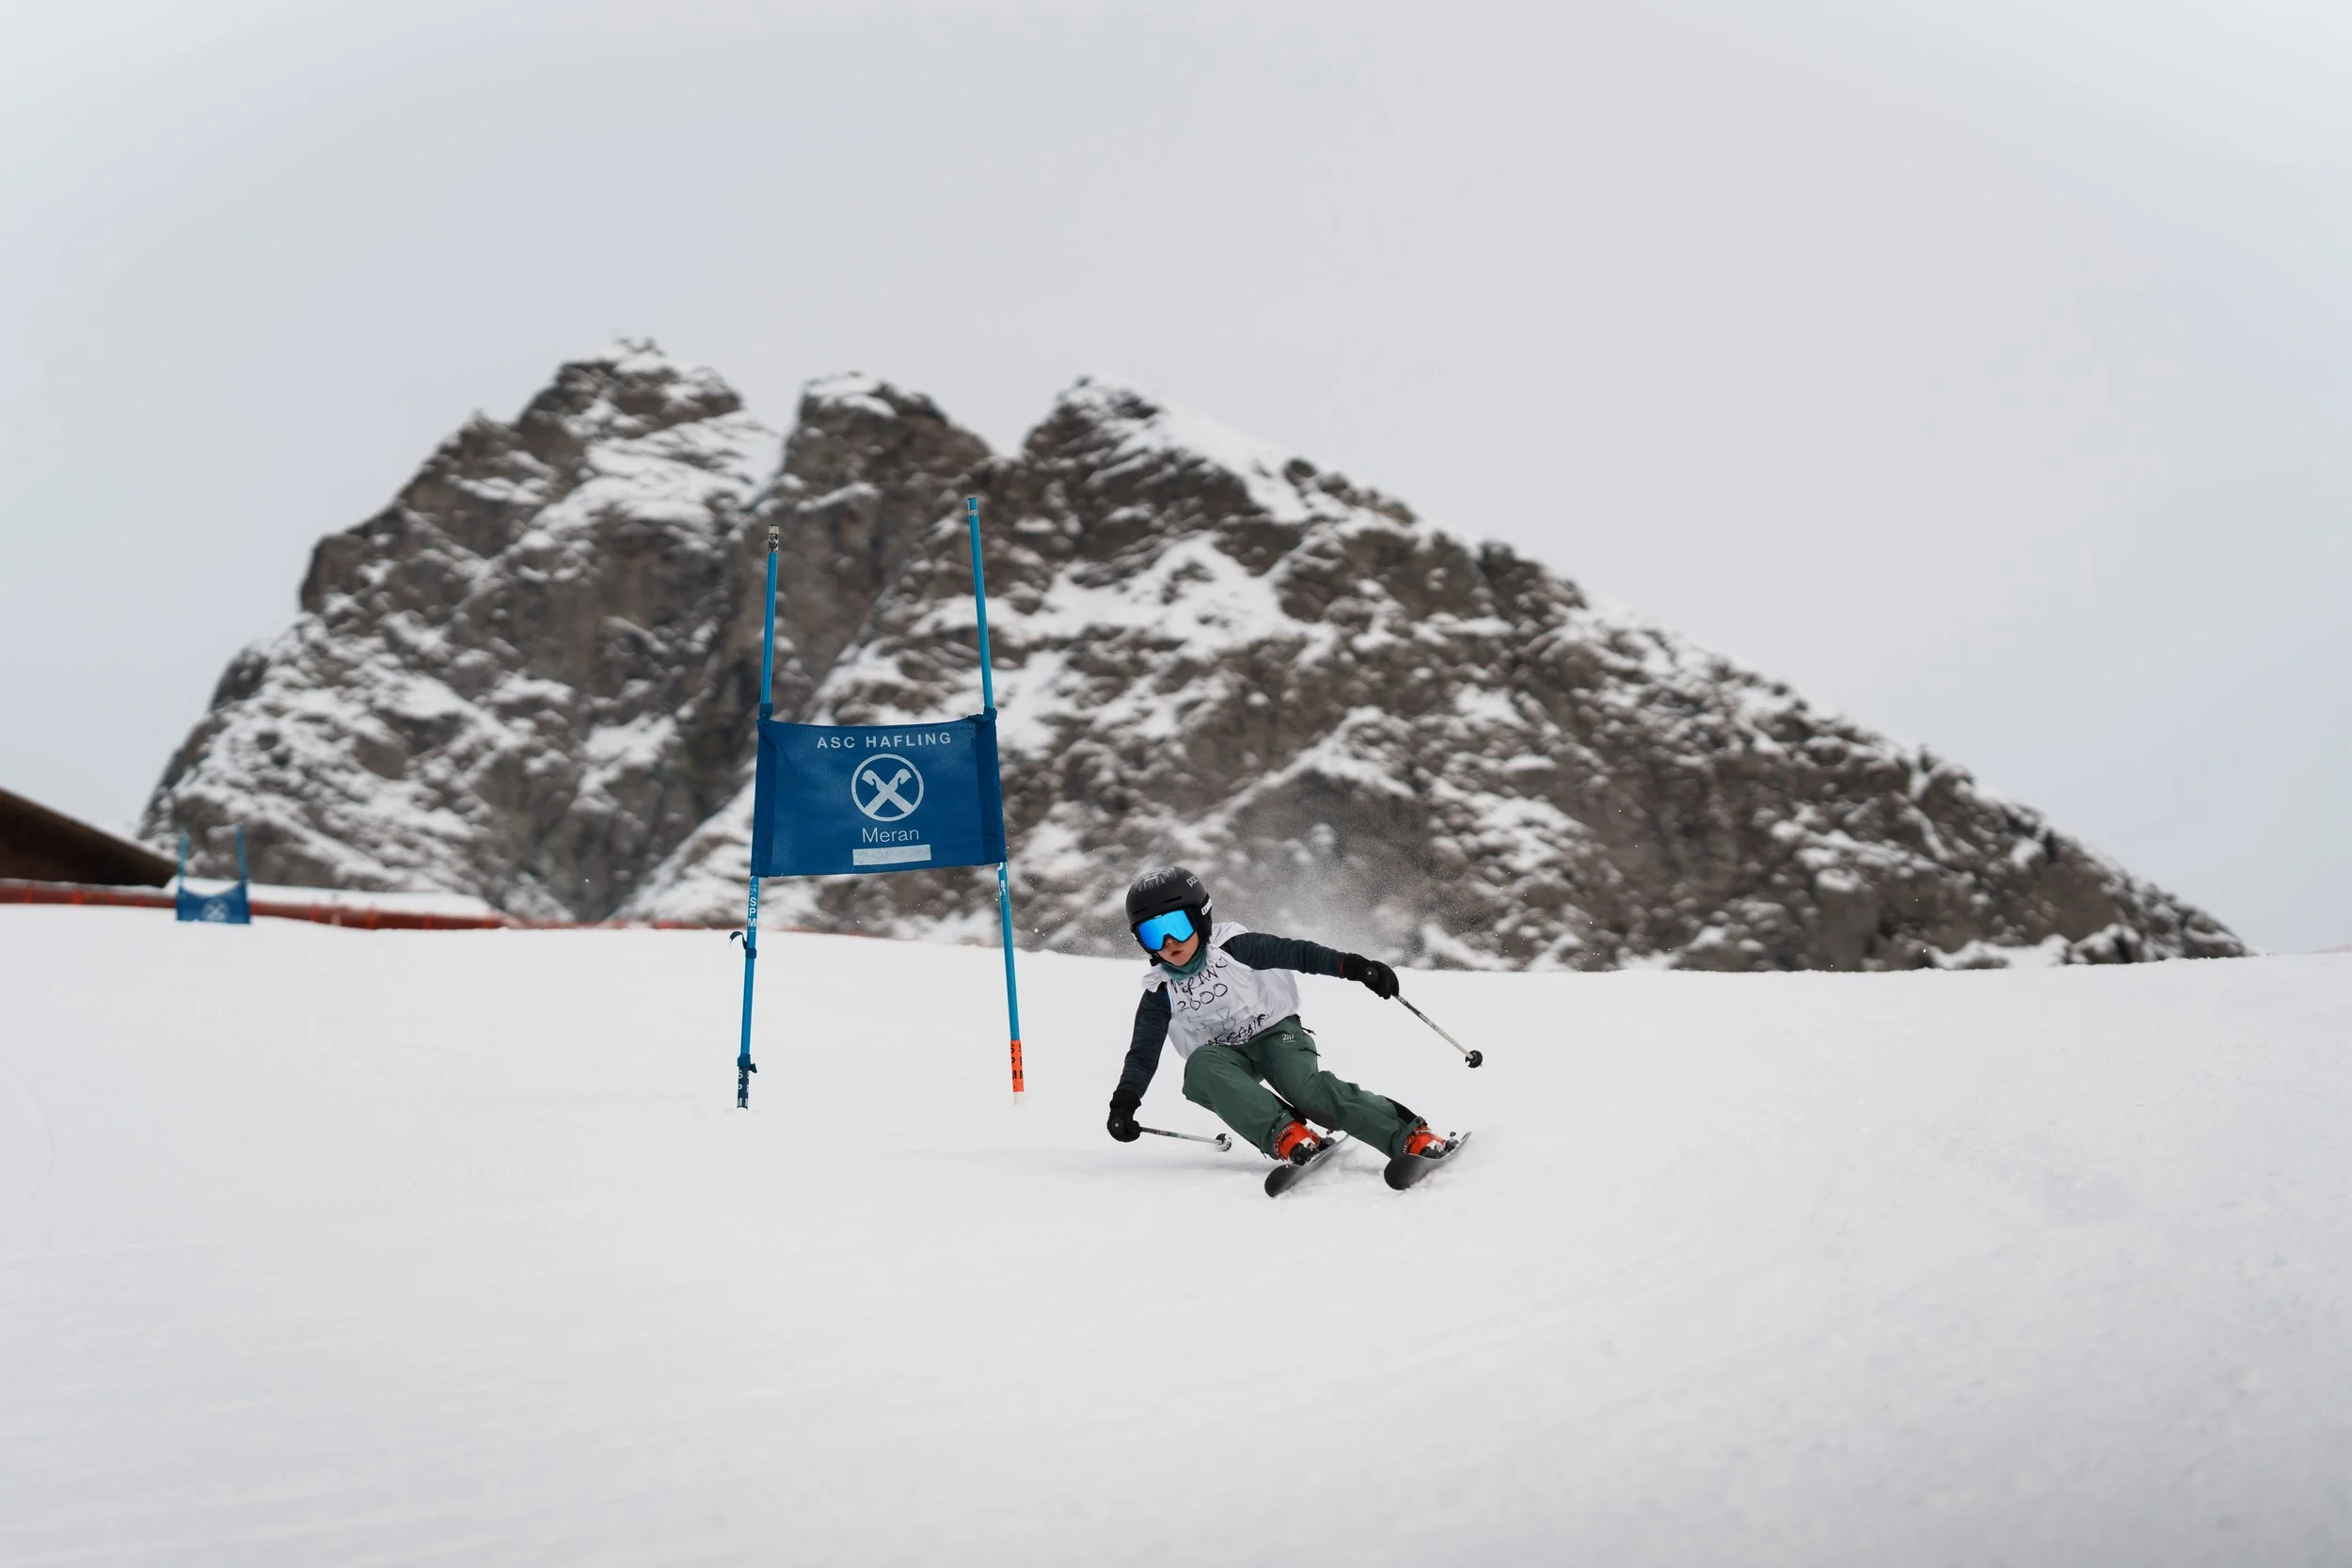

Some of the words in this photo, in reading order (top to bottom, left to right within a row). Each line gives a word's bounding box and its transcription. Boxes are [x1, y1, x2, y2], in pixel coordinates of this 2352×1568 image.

[817, 736, 855, 749] ASC
[866, 732, 951, 748] HAFLING
[862, 827, 919, 843] Meran
[1177, 983, 1229, 1013] 2000
